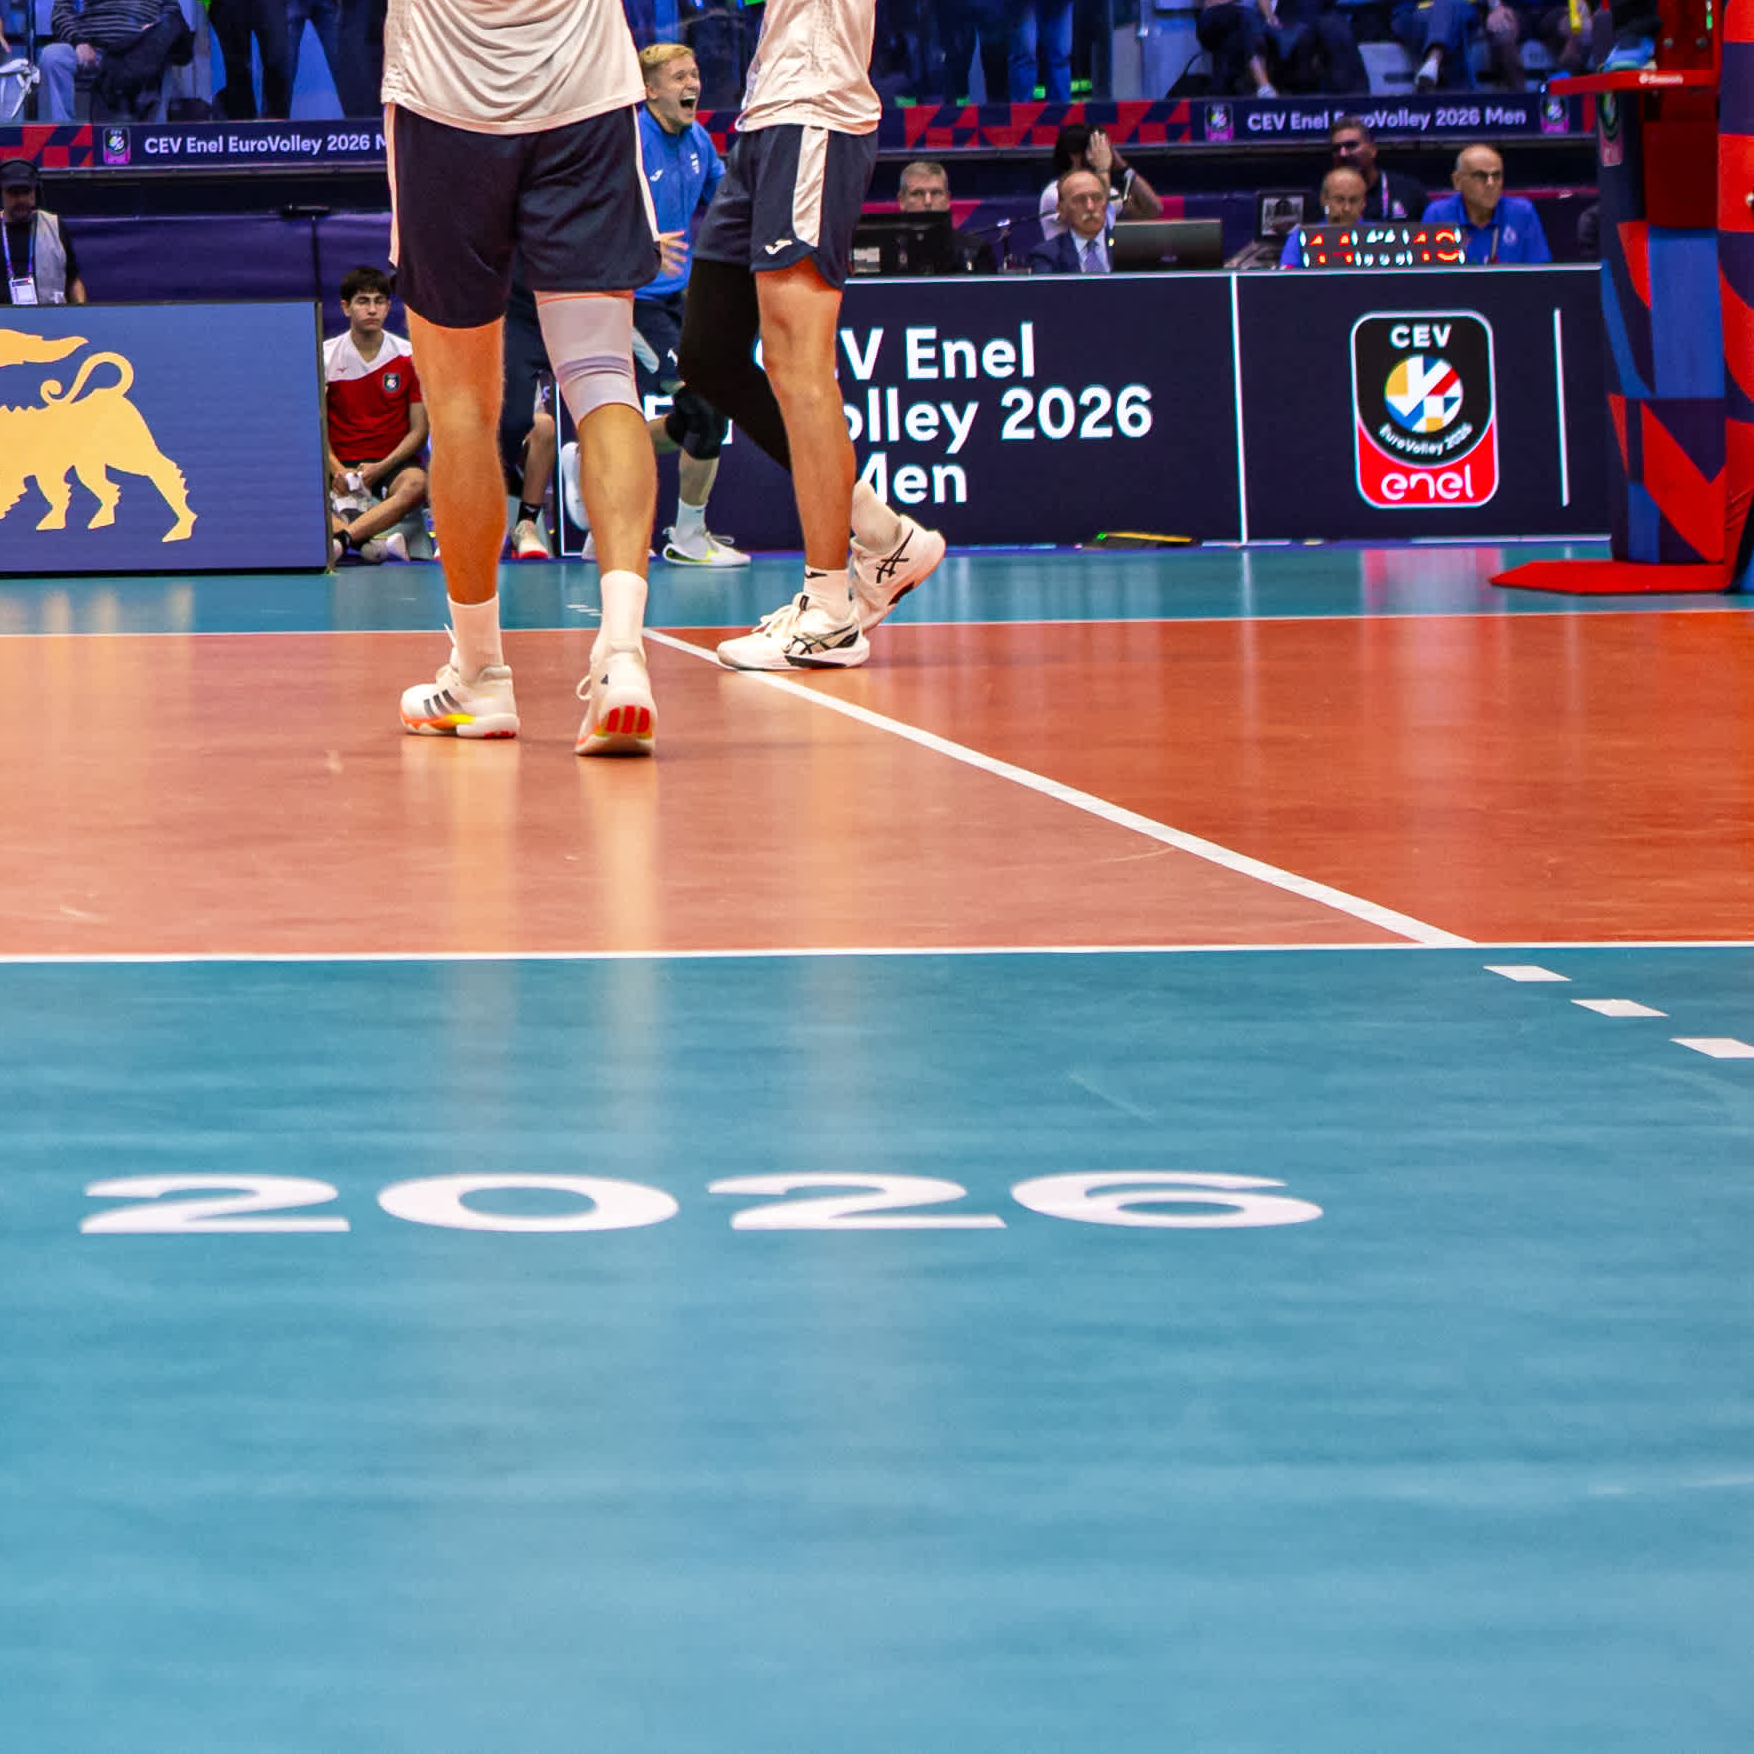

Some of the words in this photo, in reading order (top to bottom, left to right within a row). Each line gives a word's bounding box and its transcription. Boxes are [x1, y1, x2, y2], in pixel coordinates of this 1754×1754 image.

[1247, 113, 1287, 131] CEV
[1290, 111, 1330, 129] Enel
[1333, 110, 1430, 131] EoVolley
[1435, 110, 1480, 127] 2026
[1484, 108, 1527, 125] Men
[145, 136, 181, 154] CEV
[186, 135, 223, 152] Enel
[228, 134, 323, 156] EuroVolley
[326, 133, 371, 151] 2026
[904, 322, 1036, 382] Enel
[1389, 324, 1454, 349] CEV
[1000, 385, 1153, 445] 2026
[1380, 463, 1476, 502] enel
[78, 1171, 1326, 1236] 2026
